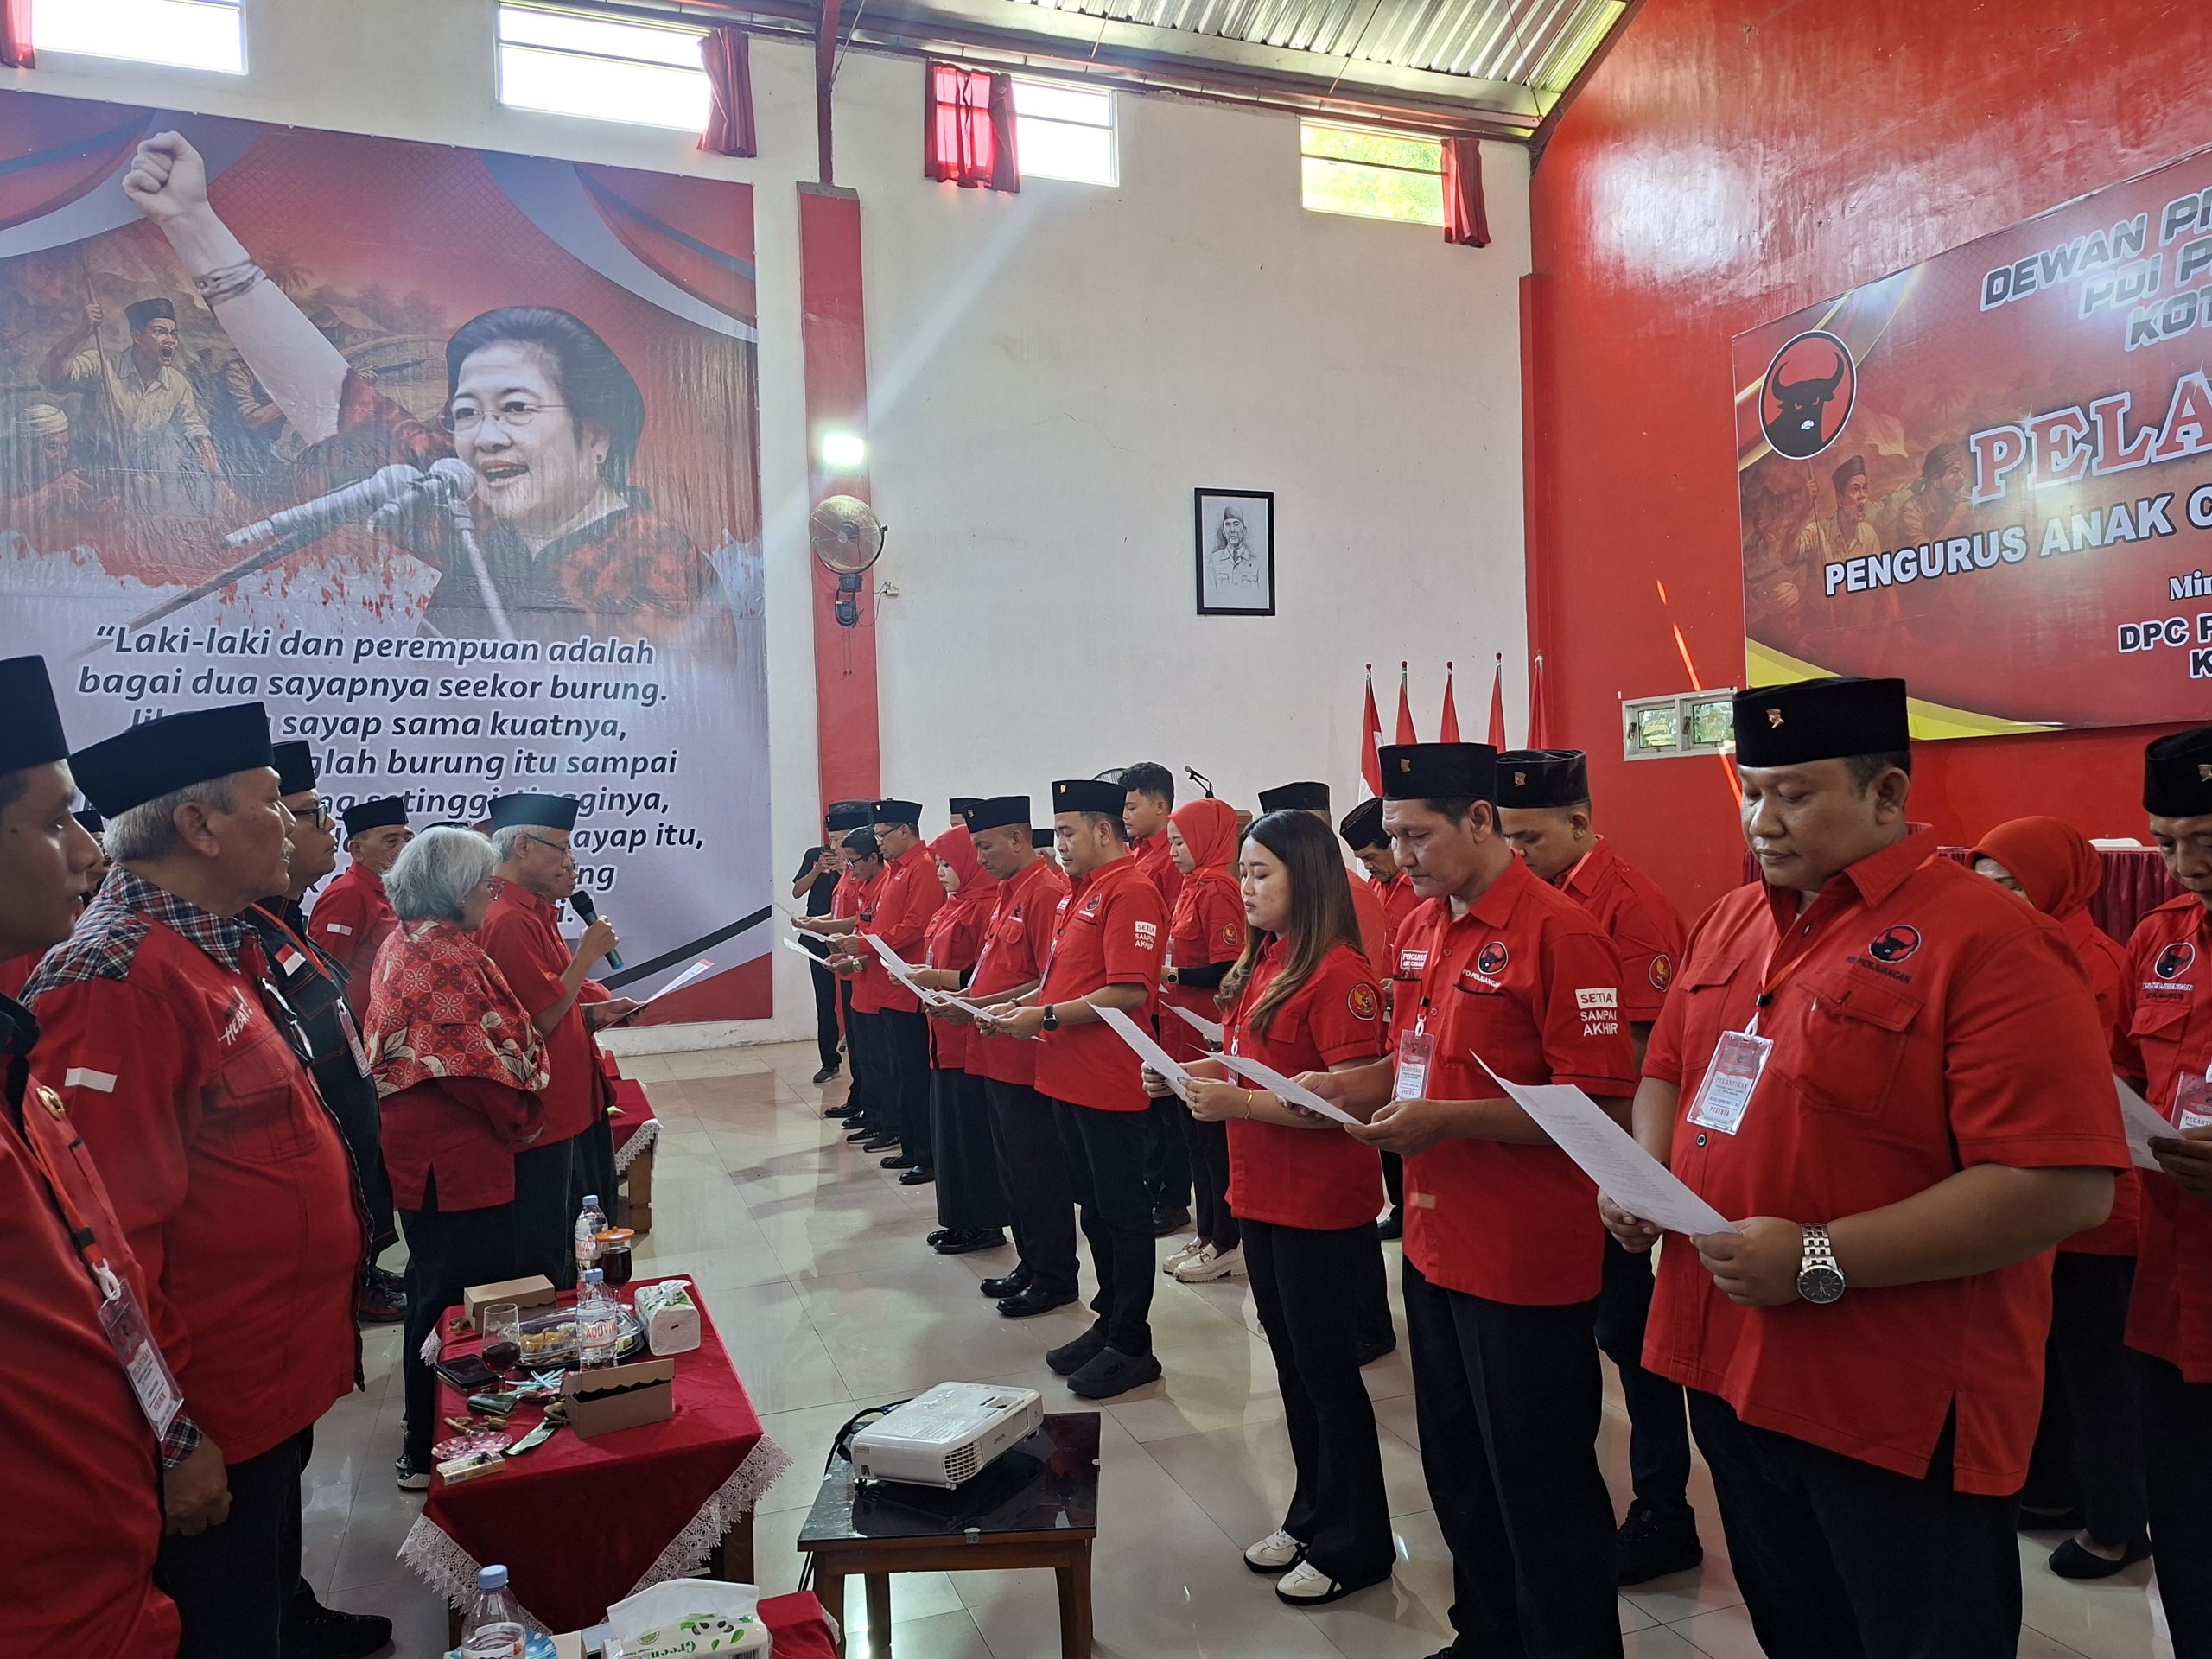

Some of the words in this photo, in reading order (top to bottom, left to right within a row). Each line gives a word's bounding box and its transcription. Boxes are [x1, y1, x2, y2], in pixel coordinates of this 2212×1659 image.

[1982, 213, 2148, 309] DEWAN
[2080, 253, 2163, 318] PDI
[1824, 525, 2029, 597] PENGURUS
[2040, 494, 2176, 557] ANAK
[280, 630, 343, 657] dan
[353, 636, 539, 665] perempuan
[549, 638, 655, 664] adalah
[2118, 618, 2189, 652] DPC
[79, 666, 183, 701] bagai
[192, 668, 257, 695] dua
[268, 675, 429, 703] sayapnya
[439, 673, 542, 698] seekor
[550, 674, 668, 707] burung.
[283, 716, 382, 741] sayap
[391, 715, 480, 736] sama
[490, 711, 627, 742] kuatnya,
[387, 749, 505, 780] burung
[514, 747, 557, 774] itu
[566, 750, 678, 779] sampai
[573, 828, 647, 854] ayap
[655, 822, 704, 849] itu,
[1137, 924, 1154, 933] SETIA
[1580, 992, 1614, 1004] SETIA
[1583, 1022, 1618, 1037] AKHIR
[650, 1640, 696, 1658] Green
